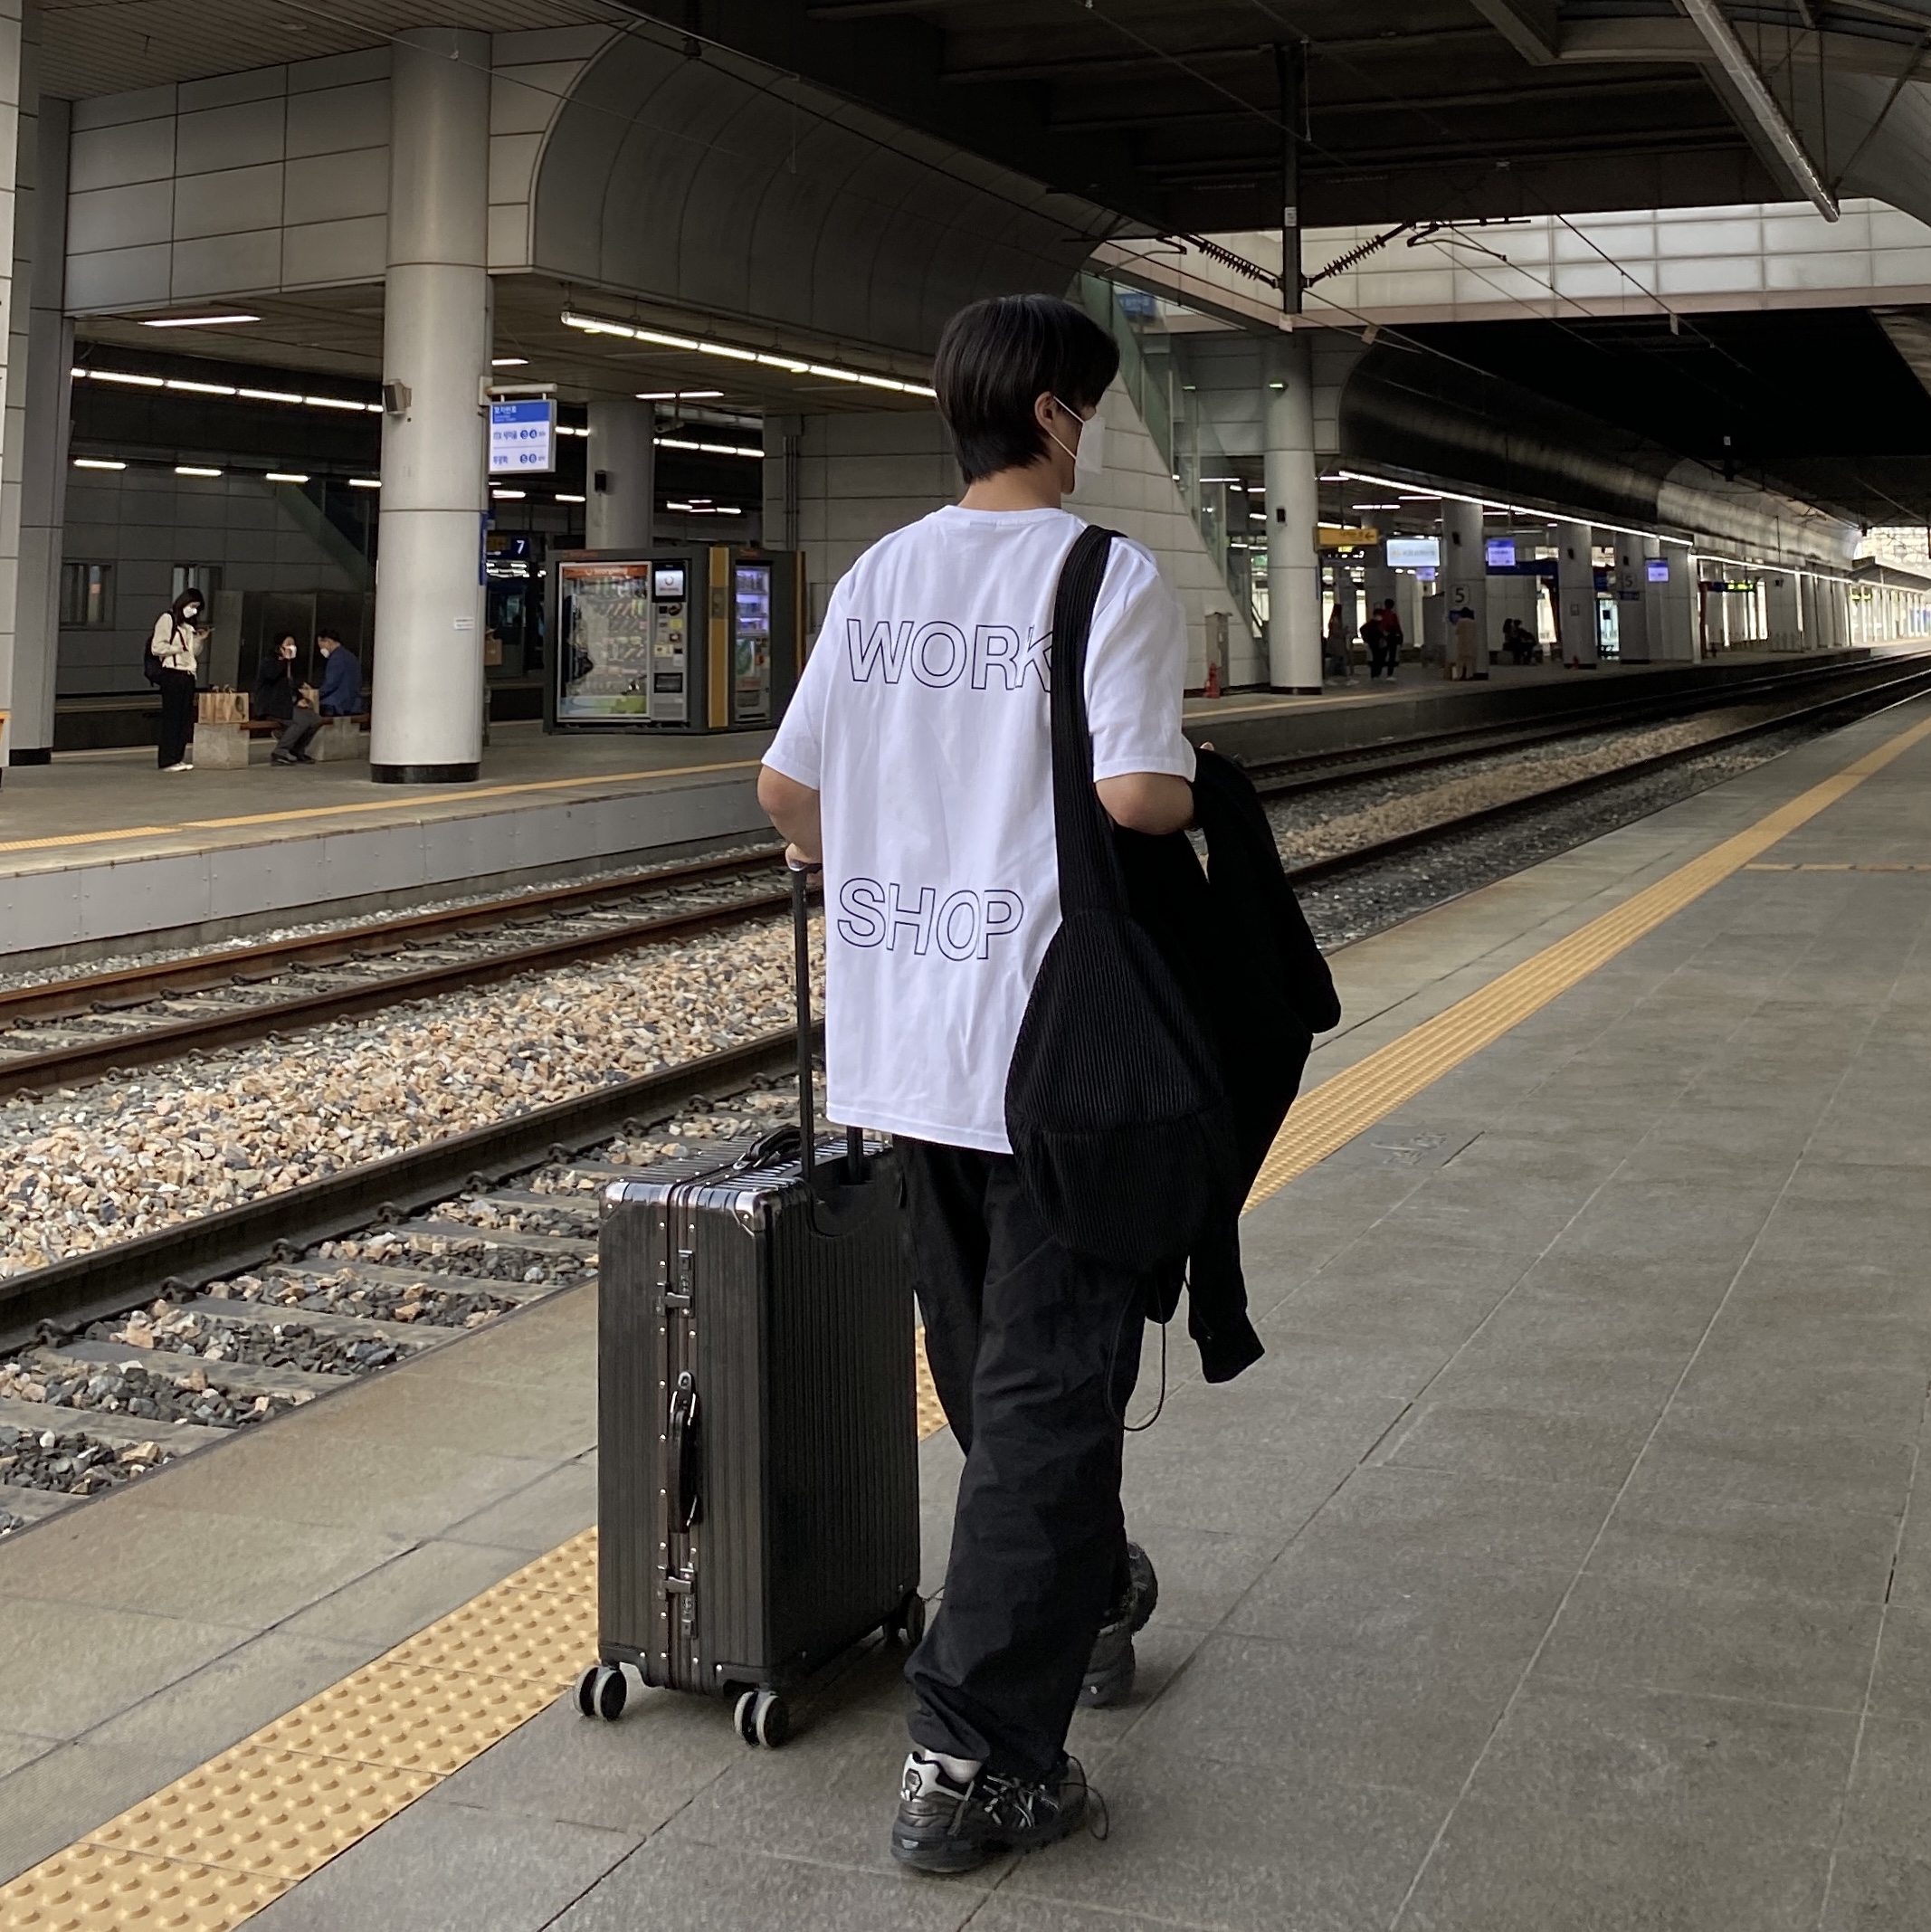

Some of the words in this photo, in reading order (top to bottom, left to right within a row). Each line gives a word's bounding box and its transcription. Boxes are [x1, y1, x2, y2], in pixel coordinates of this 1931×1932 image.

[517, 539, 525, 554] 7
[1454, 587, 1465, 604] 5
[847, 618, 1053, 692] WORK
[837, 877, 1024, 962] SHOP
